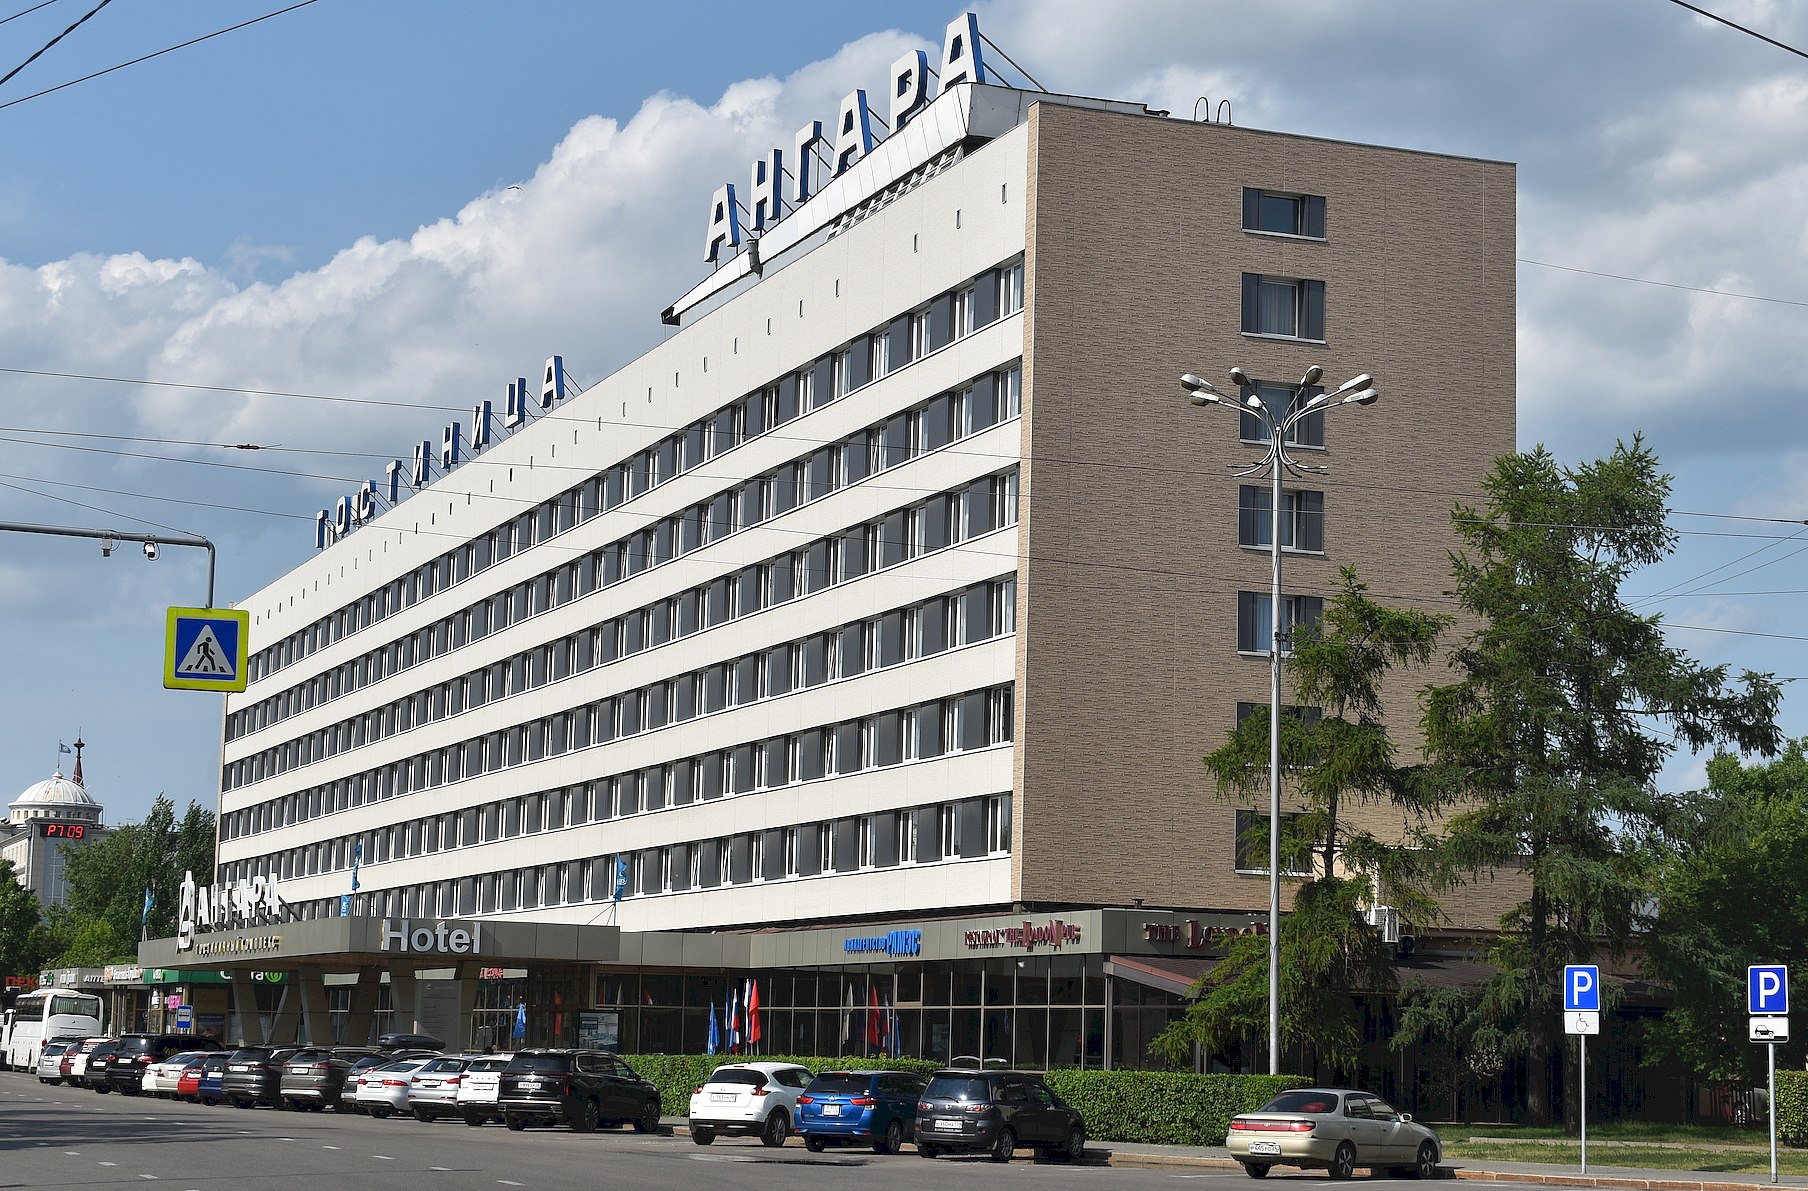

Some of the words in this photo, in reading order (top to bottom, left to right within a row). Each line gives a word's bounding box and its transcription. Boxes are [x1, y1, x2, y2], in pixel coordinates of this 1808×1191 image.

[703, 12, 985, 262] АНГАРА
[314, 355, 565, 549] ГОСТИНИЦА
[197, 873, 279, 925] АНГАРА
[381, 918, 481, 954] Hotel
[1574, 971, 1592, 1006] P
[1759, 971, 1780, 1008] P
